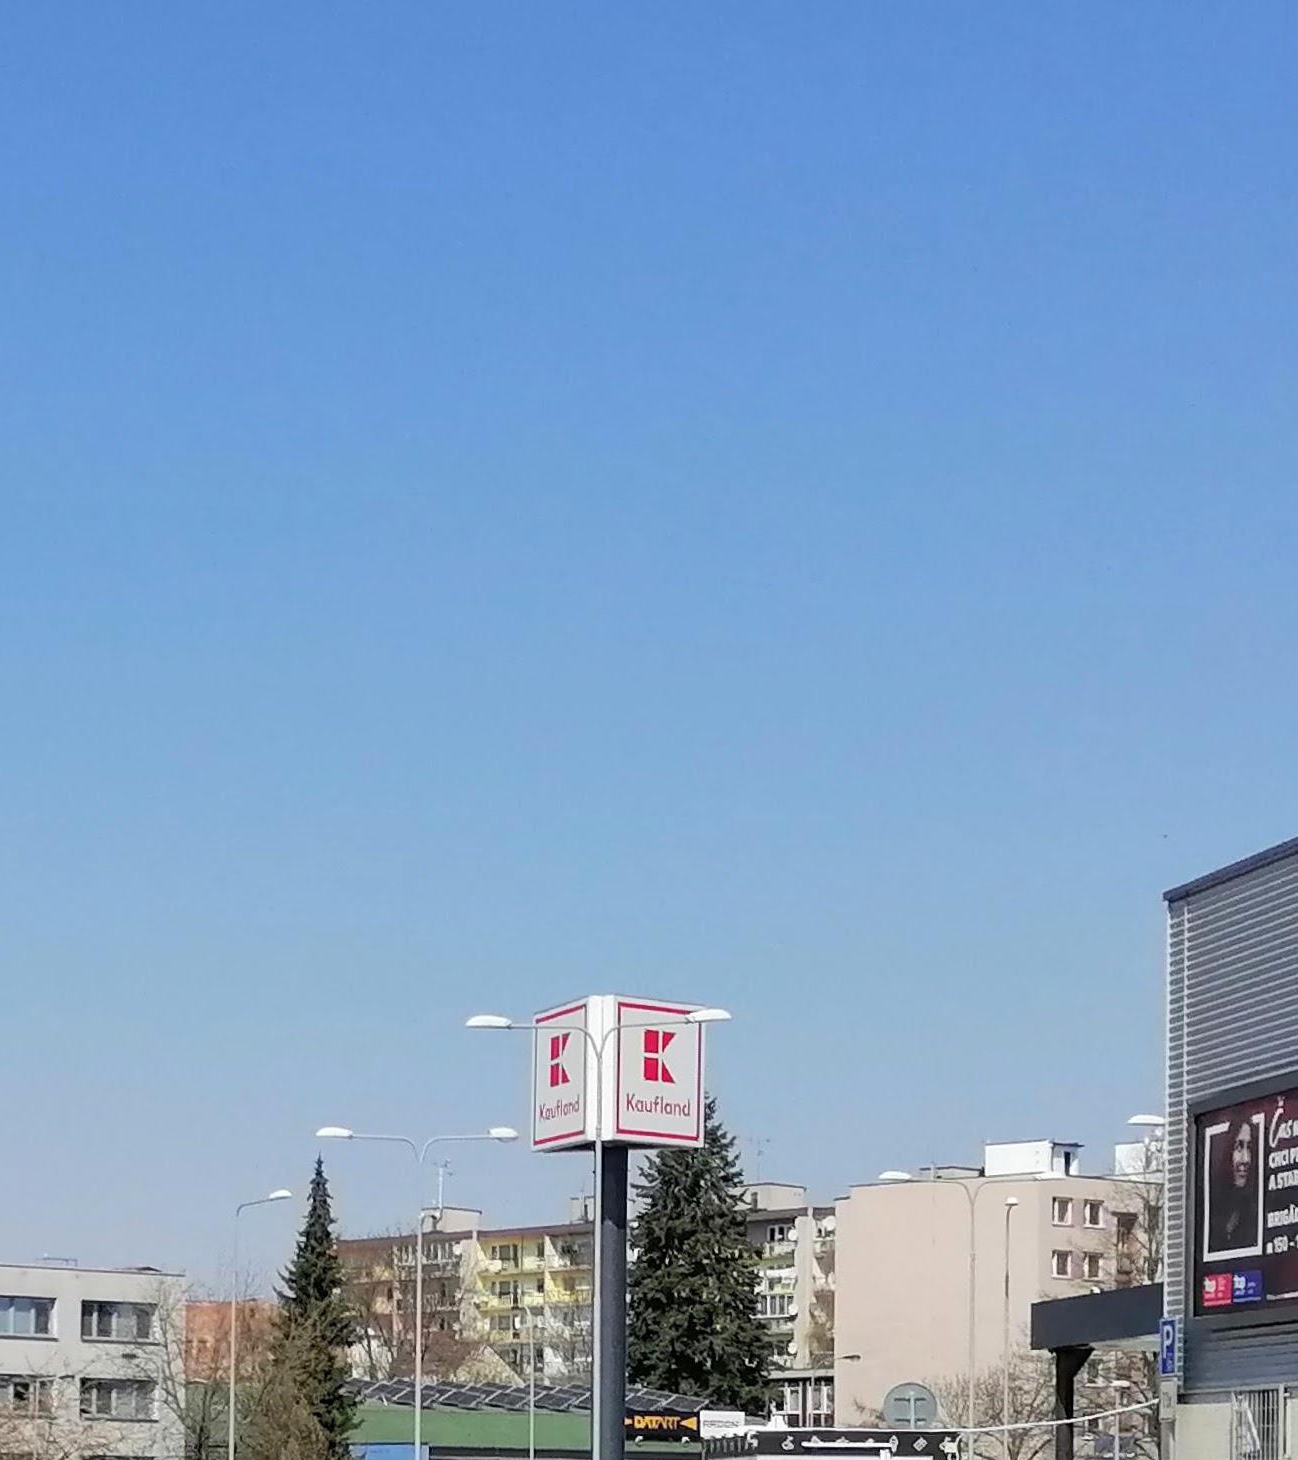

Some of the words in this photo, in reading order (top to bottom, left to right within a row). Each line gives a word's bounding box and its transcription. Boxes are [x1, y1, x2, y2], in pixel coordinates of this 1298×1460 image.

[539, 1094, 580, 1121] Kaufland
[626, 1093, 691, 1117] Kaufland
[634, 1415, 680, 1429] DATART
